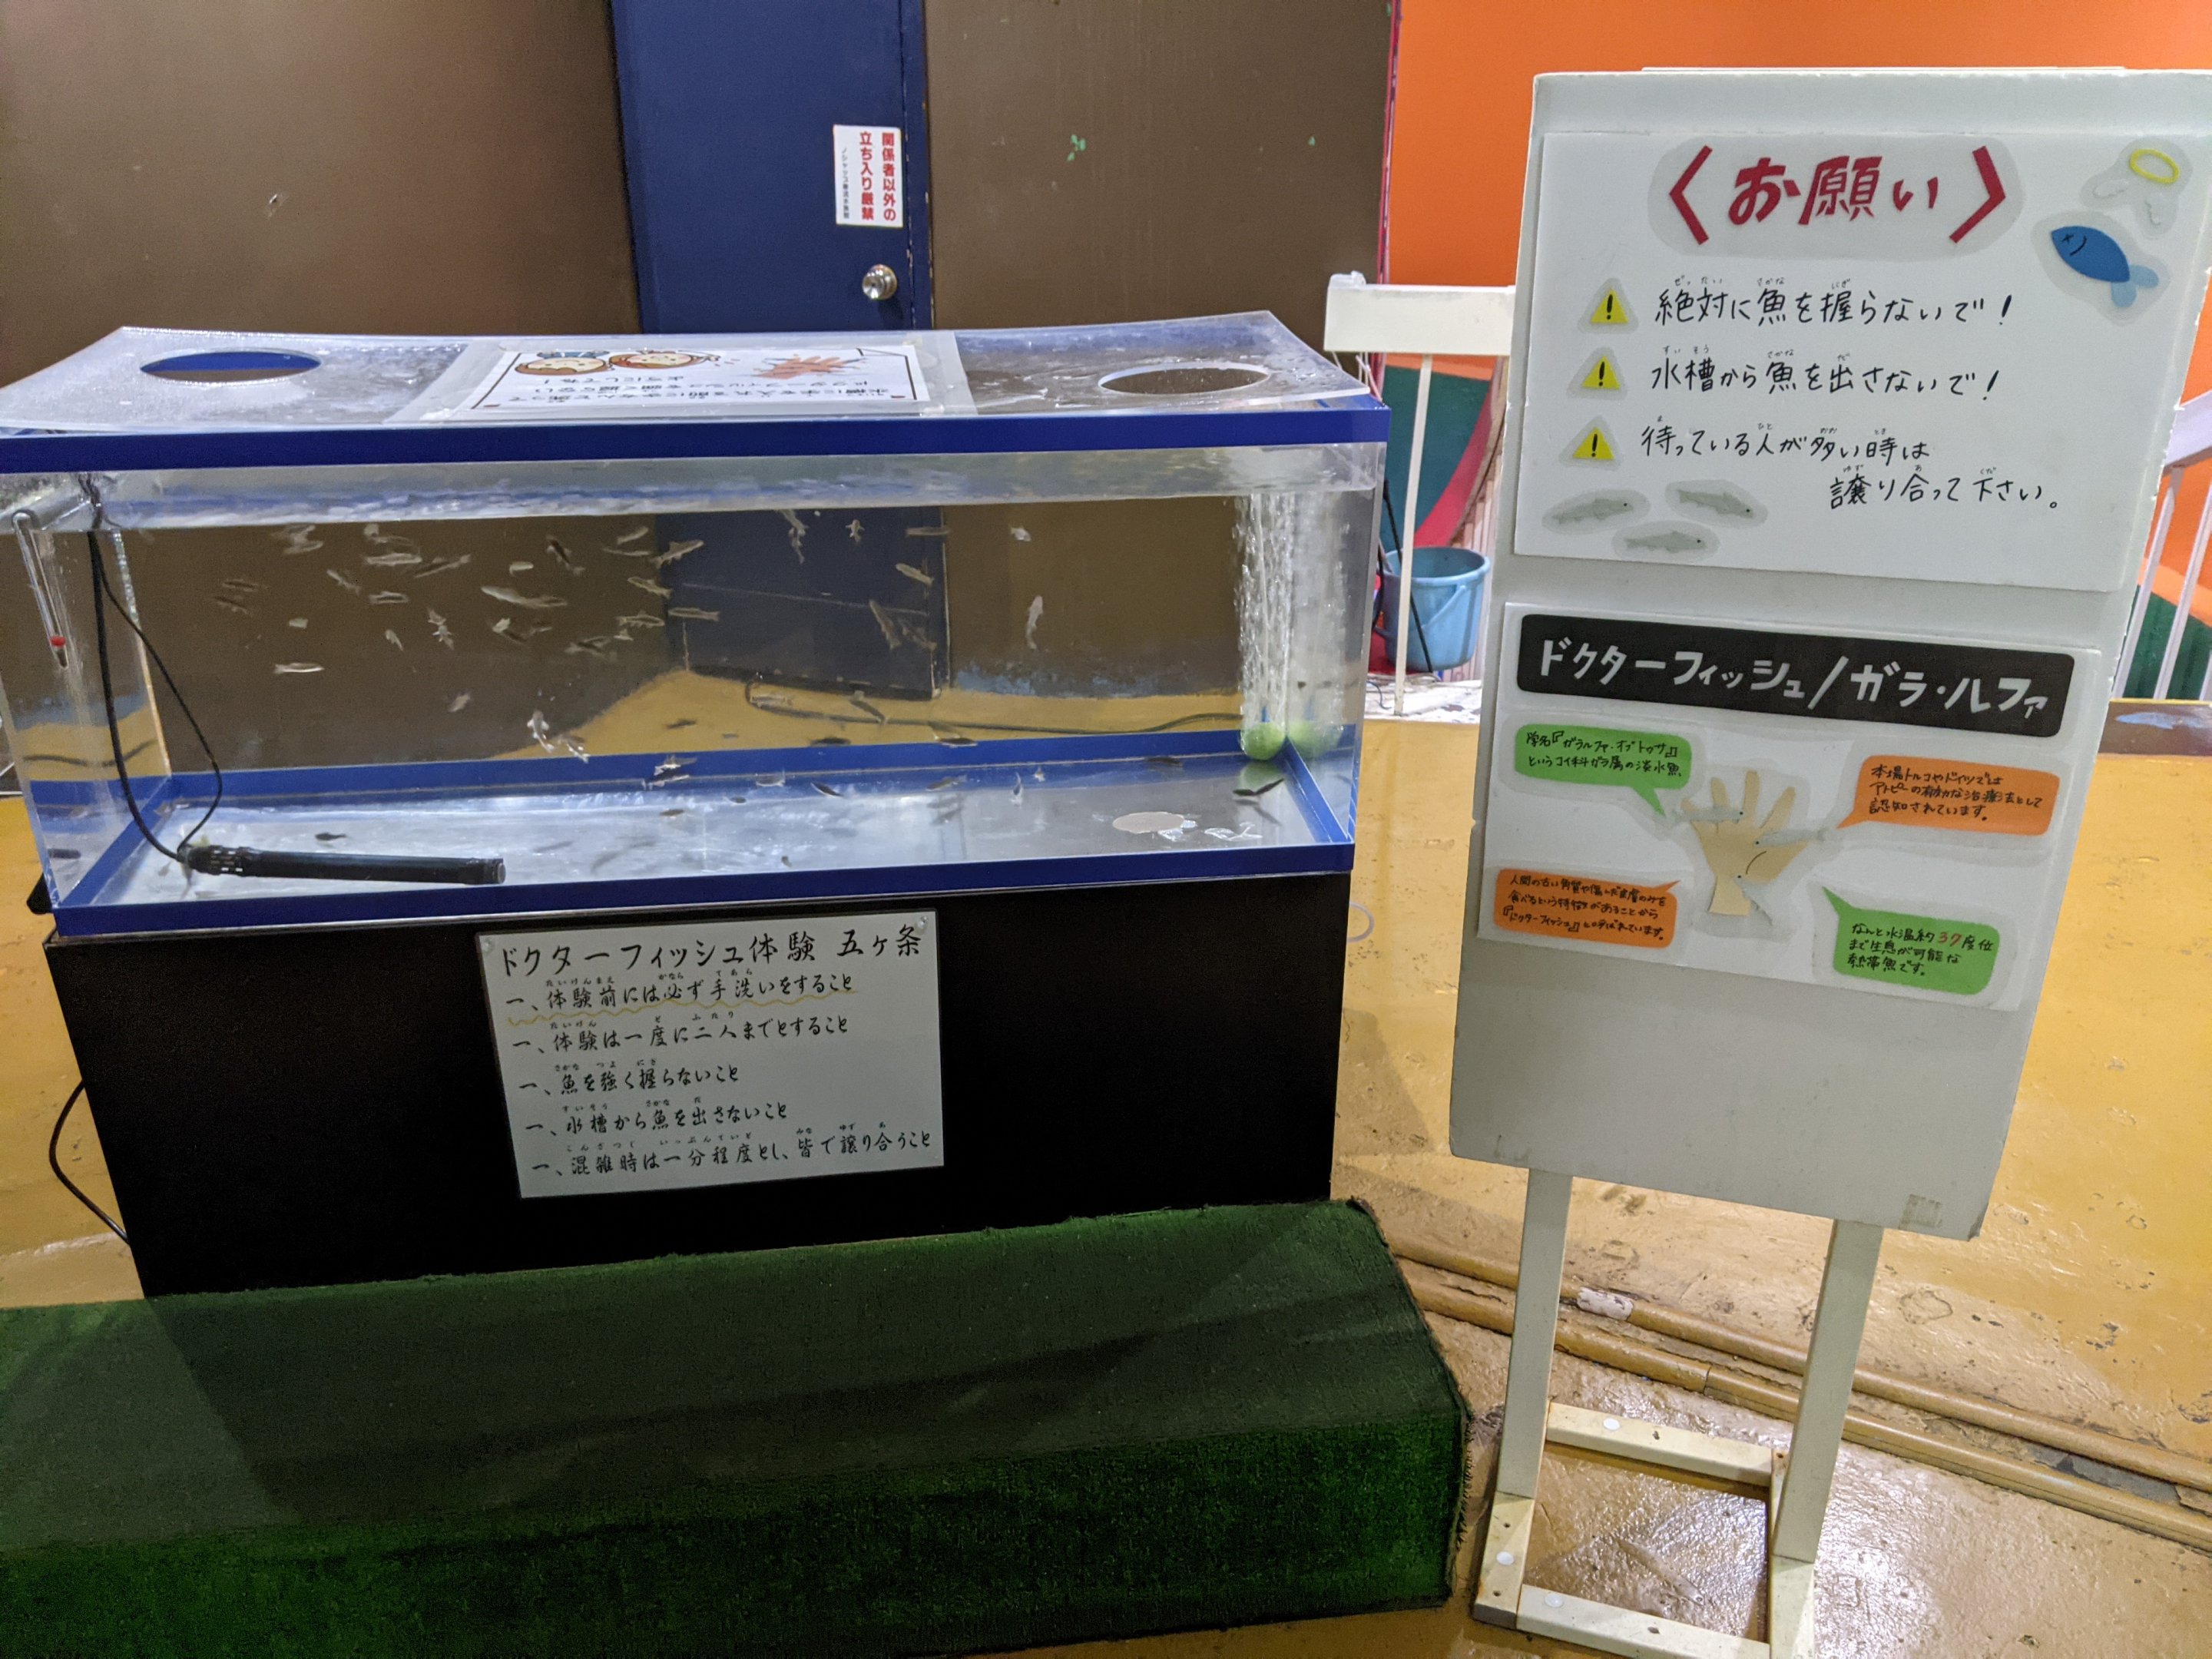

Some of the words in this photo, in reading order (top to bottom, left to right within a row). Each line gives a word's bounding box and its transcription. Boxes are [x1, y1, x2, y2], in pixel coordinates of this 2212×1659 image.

[859, 131, 874, 220] 立ち入り厳禁
[882, 132, 896, 221] 関係者以外の
[1641, 425, 1930, 466] 待っている人が多い時は
[1871, 764, 2003, 785] 本場トルコやドイツでは
[502, 930, 816, 977] ドクターフィッシュ体験
